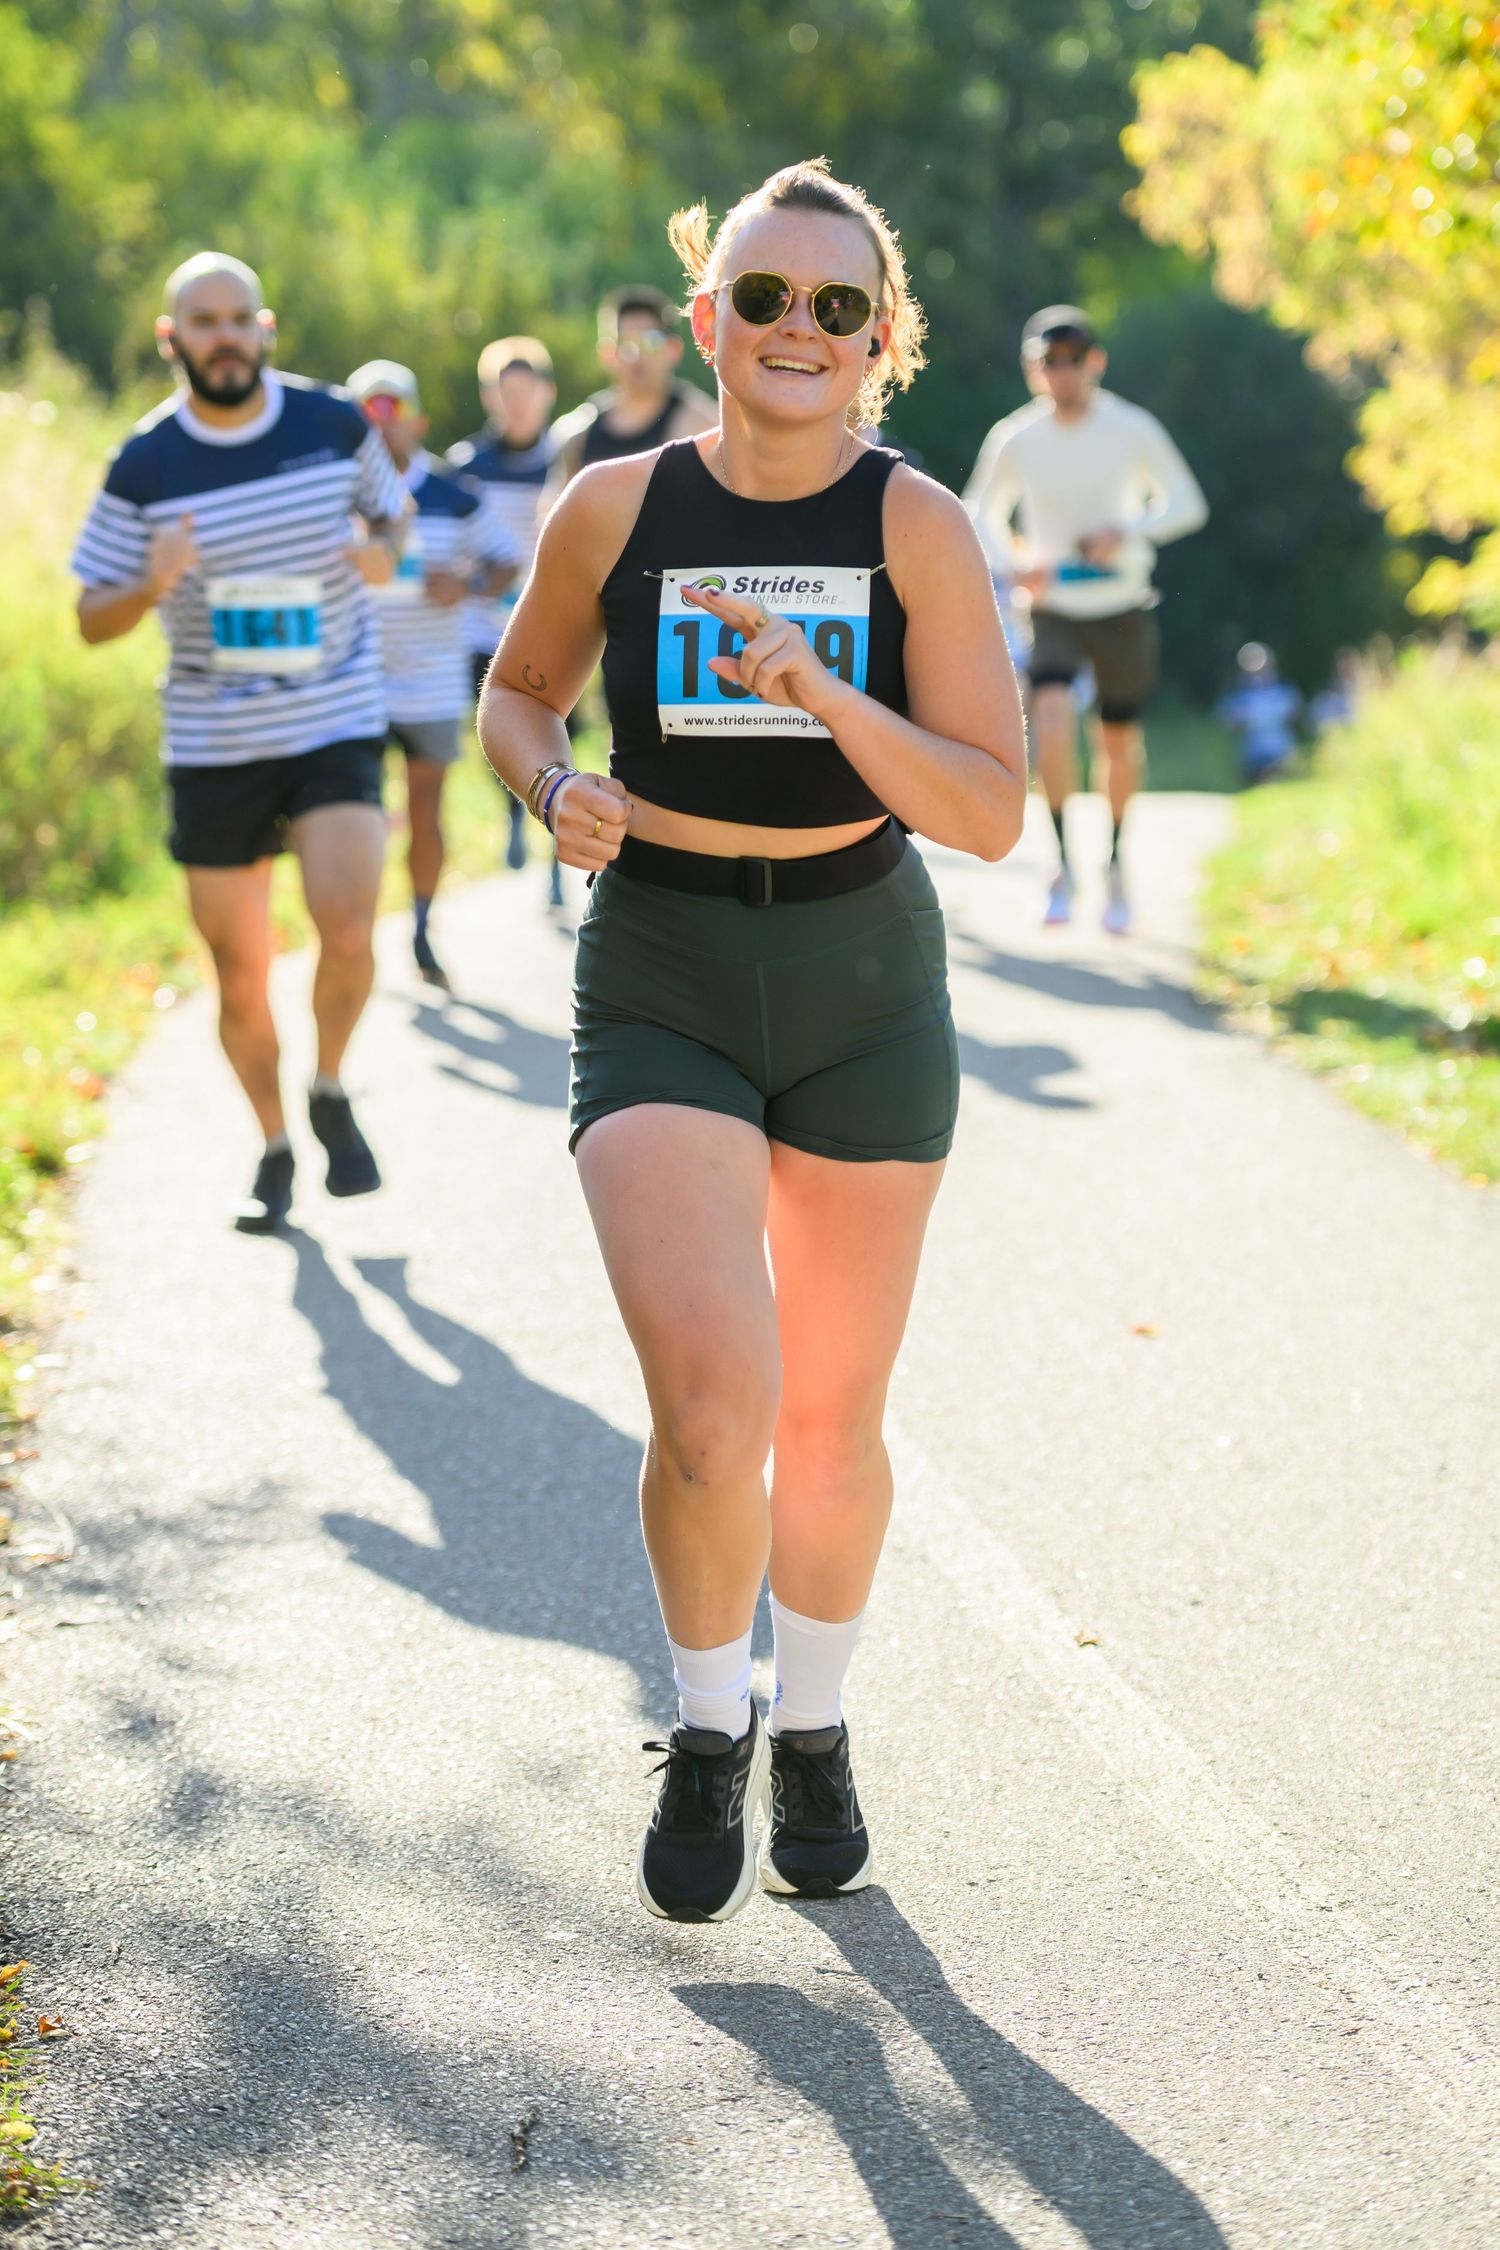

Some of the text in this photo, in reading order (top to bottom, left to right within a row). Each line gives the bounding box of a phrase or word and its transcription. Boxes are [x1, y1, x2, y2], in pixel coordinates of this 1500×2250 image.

[732, 576, 825, 593] Strides
[748, 594, 838, 605] NING STORE
[673, 620, 855, 698] 169
[684, 715, 825, 728] www.stridesrunning.co
